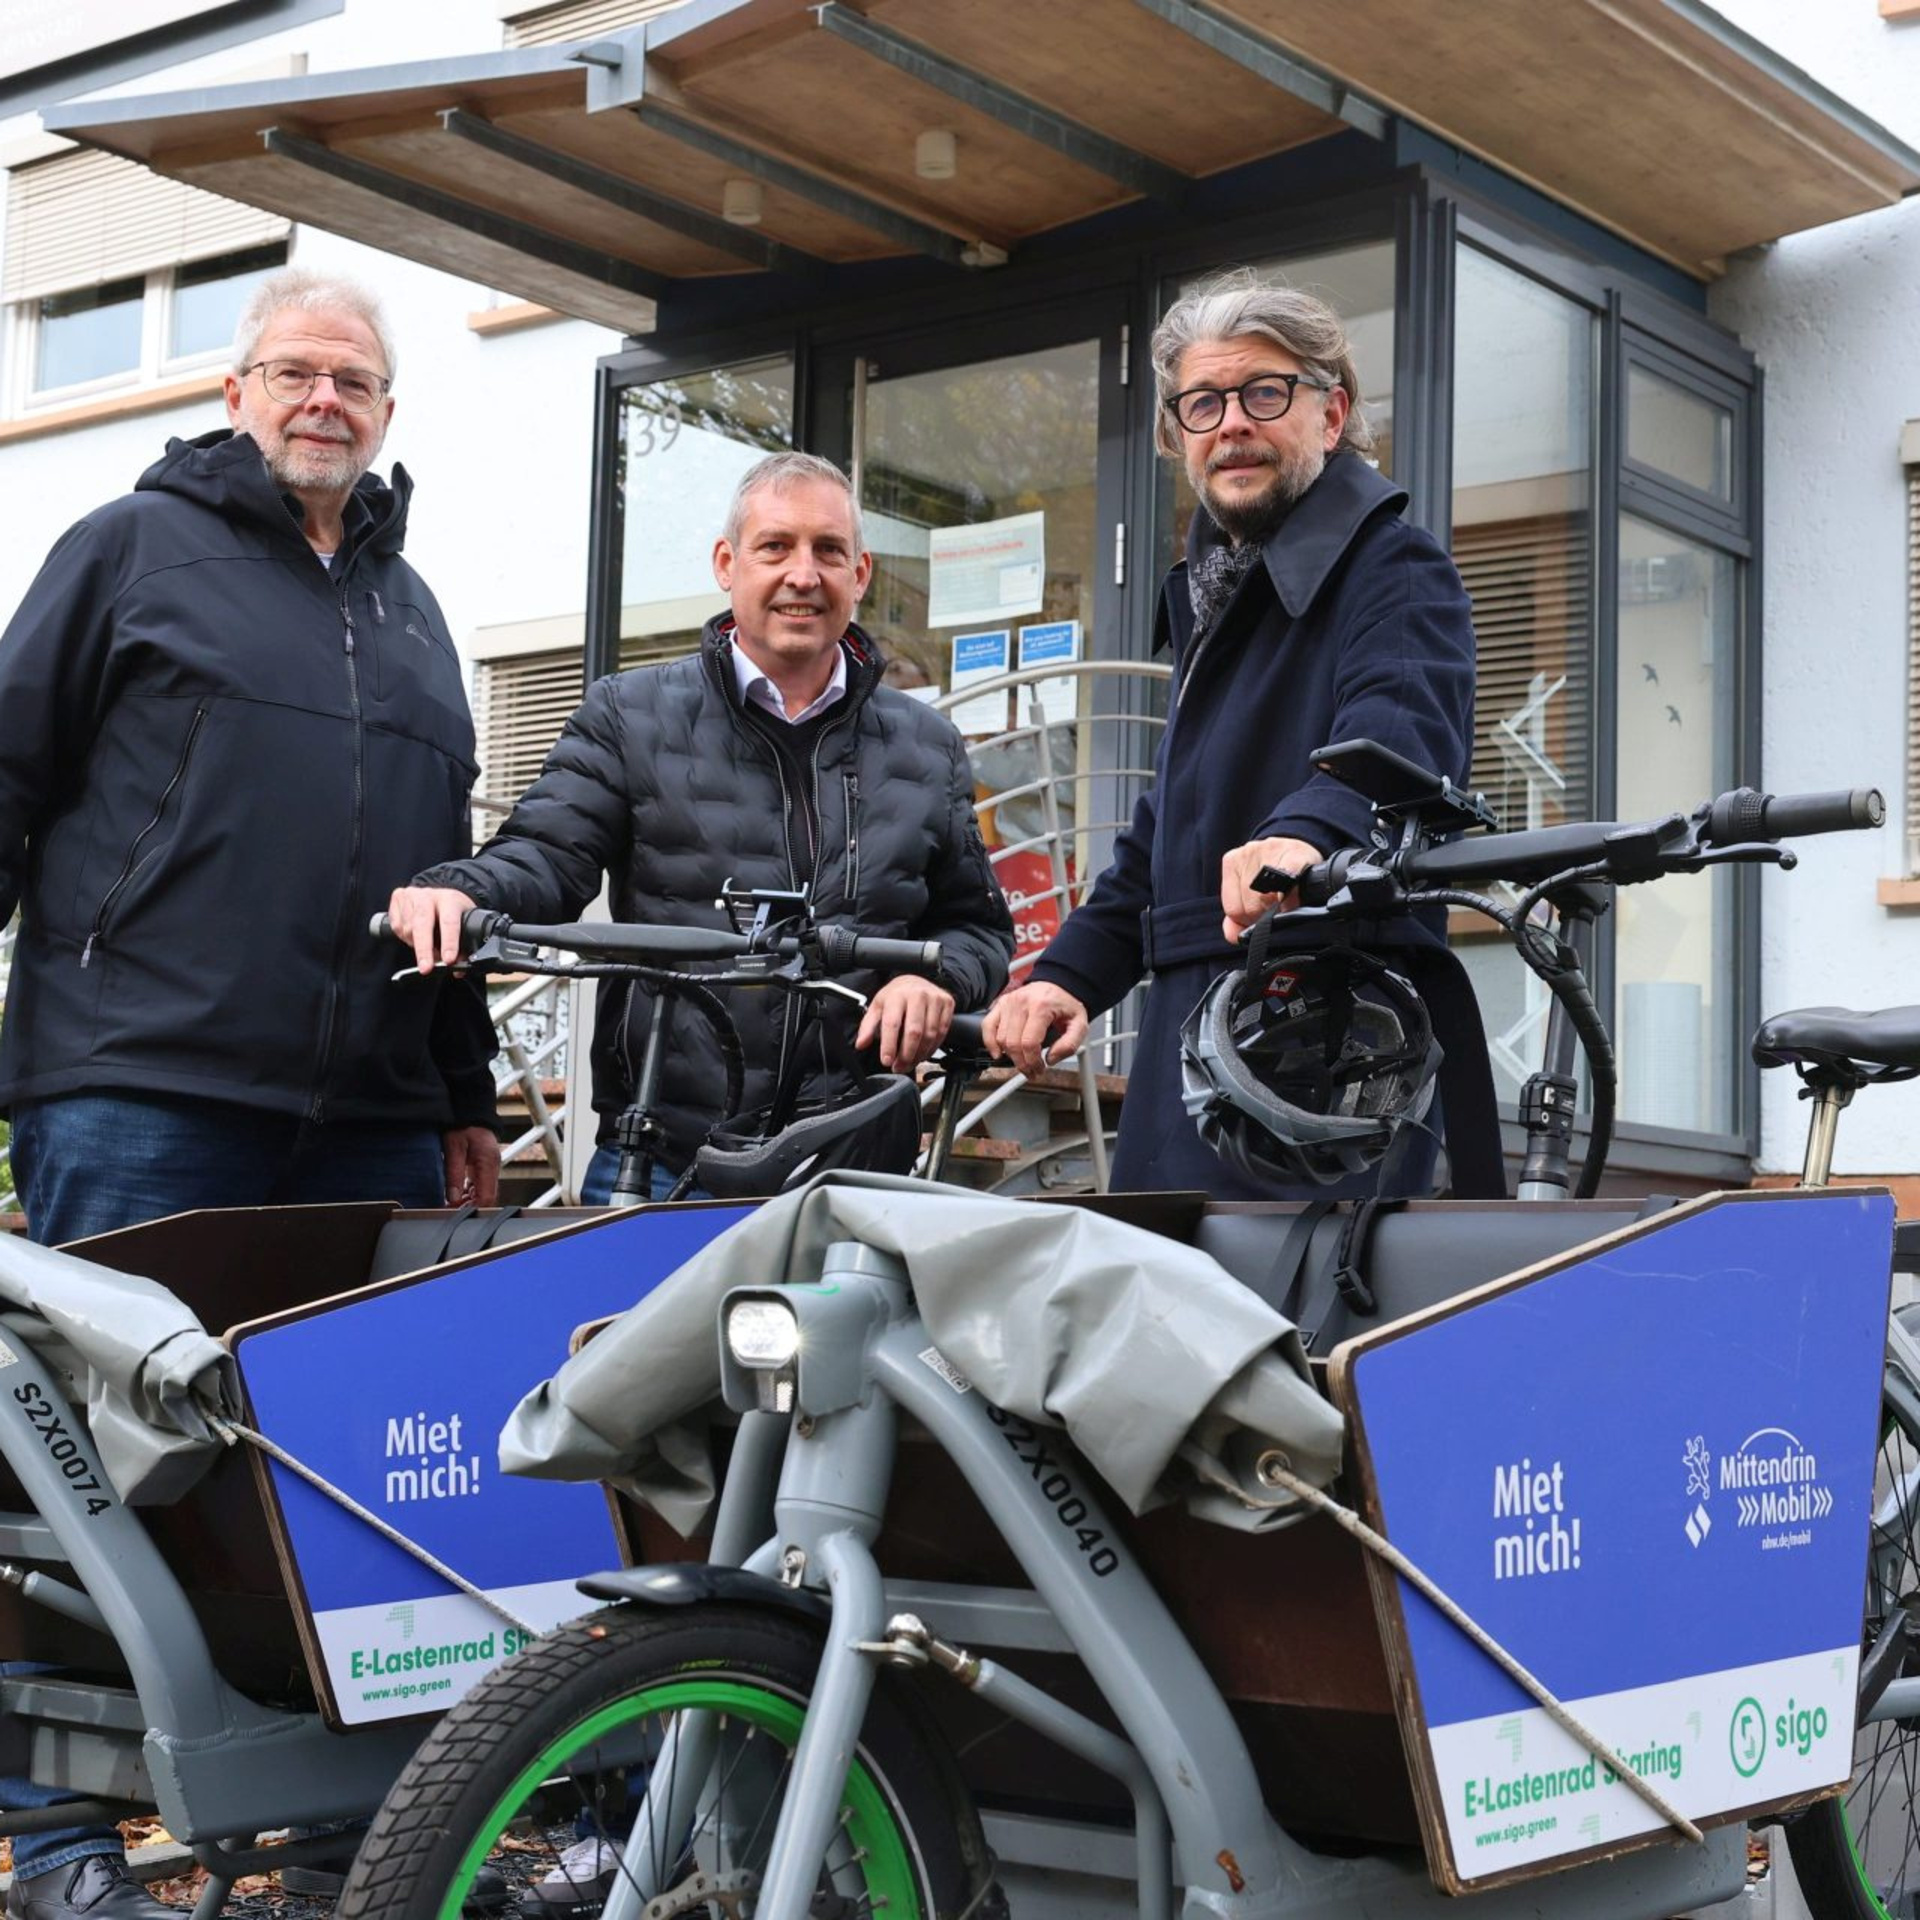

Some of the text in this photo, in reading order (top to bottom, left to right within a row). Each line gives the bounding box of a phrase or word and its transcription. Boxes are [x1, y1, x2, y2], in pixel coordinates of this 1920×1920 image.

[634, 402, 682, 457] 39
[13, 1382, 112, 1517] S2X0074
[385, 1411, 463, 1458] Miet
[386, 1453, 480, 1503] mich!
[1493, 1457, 1564, 1519] Miet
[1719, 1445, 1816, 1490] Mittendrin
[1494, 1513, 1581, 1580] mich!
[1761, 1529, 1812, 1551] nhw.de/mobil
[350, 1631, 495, 1680] E-Lastenrad
[362, 1677, 452, 1702] www.sigo.green
[1775, 1698, 1828, 1756] sigo
[1464, 1750, 1596, 1818] E-Lastenrad
[1475, 1816, 1558, 1848] www.sigo.green
